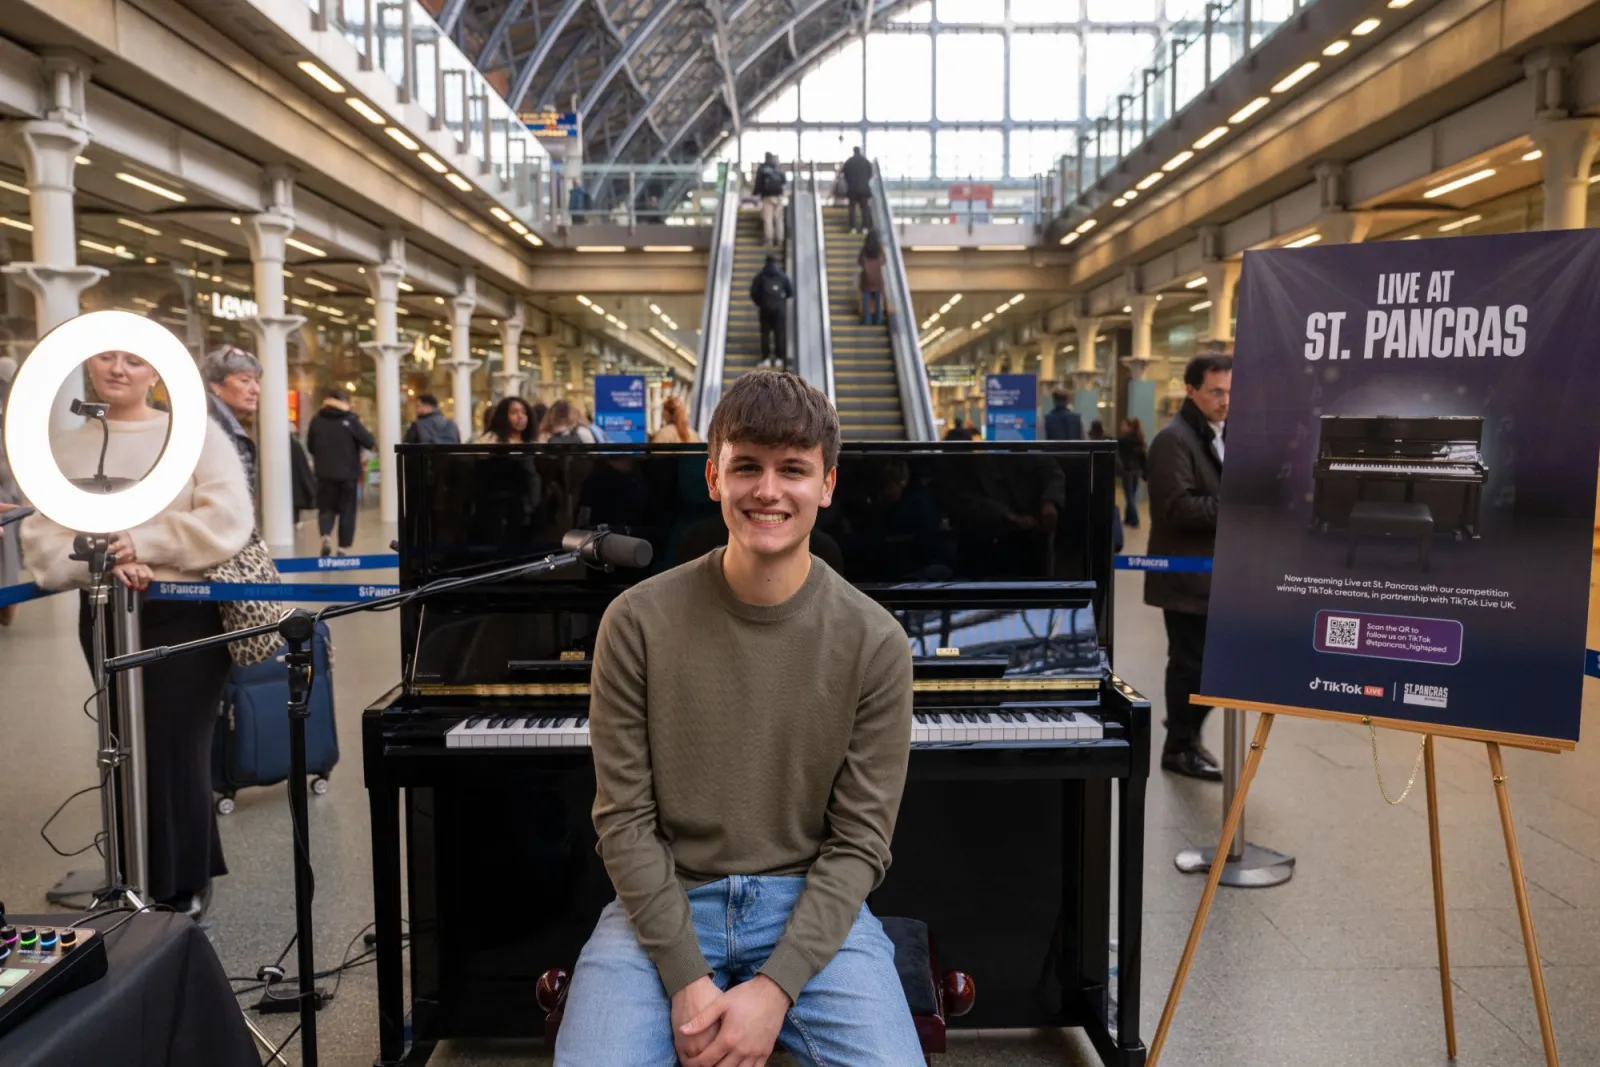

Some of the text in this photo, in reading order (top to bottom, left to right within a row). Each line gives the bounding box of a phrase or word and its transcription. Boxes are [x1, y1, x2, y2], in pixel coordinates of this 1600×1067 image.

[1377, 270, 1455, 305] LIVE AT
[1304, 304, 1528, 361] ST. PANCRAS
[1284, 574, 1509, 598] Now streaming Live at St. Pancras with our competition
[1276, 584, 1516, 610] winning TikTok creators, in partnership with TikTok Live UK.
[1366, 631, 1387, 640] follow
[1408, 634, 1431, 644] TikTok
[1367, 623, 1384, 631] Scan
[1386, 625, 1397, 633] the
[1398, 626, 1410, 634] QR
[1365, 639, 1447, 654] @stpancras_highspeed
[1322, 681, 1382, 696] TikTok LIVE
